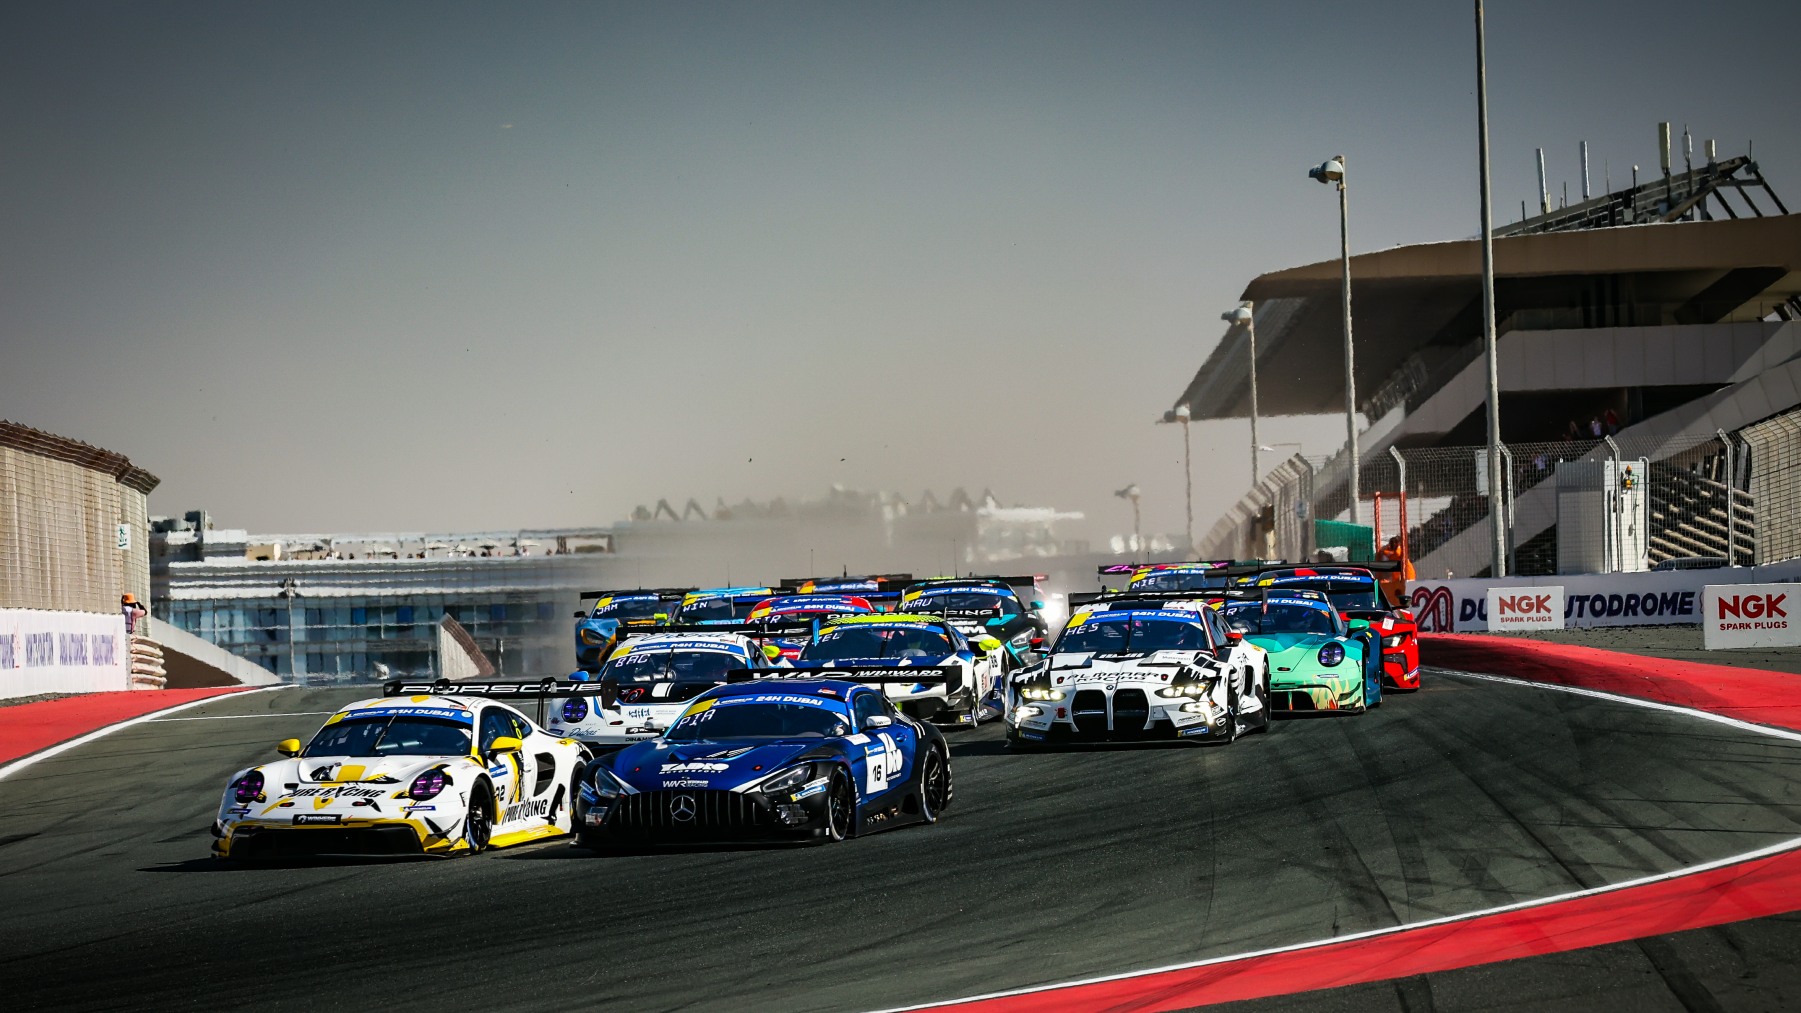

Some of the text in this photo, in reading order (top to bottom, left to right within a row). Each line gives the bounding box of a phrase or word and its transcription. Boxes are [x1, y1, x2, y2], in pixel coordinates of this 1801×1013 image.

[1499, 594, 1552, 614] NGK
[1564, 591, 1695, 618] UTODROME
[1718, 593, 1787, 620] NGK
[1065, 622, 1099, 636] HES
[1754, 621, 1787, 630] PLUGS
[400, 684, 602, 693] PORSCHE
[783, 696, 823, 706] DUBAI
[414, 709, 455, 717] DUBAI
[677, 709, 717, 730] PIA
[872, 764, 882, 782] 16
